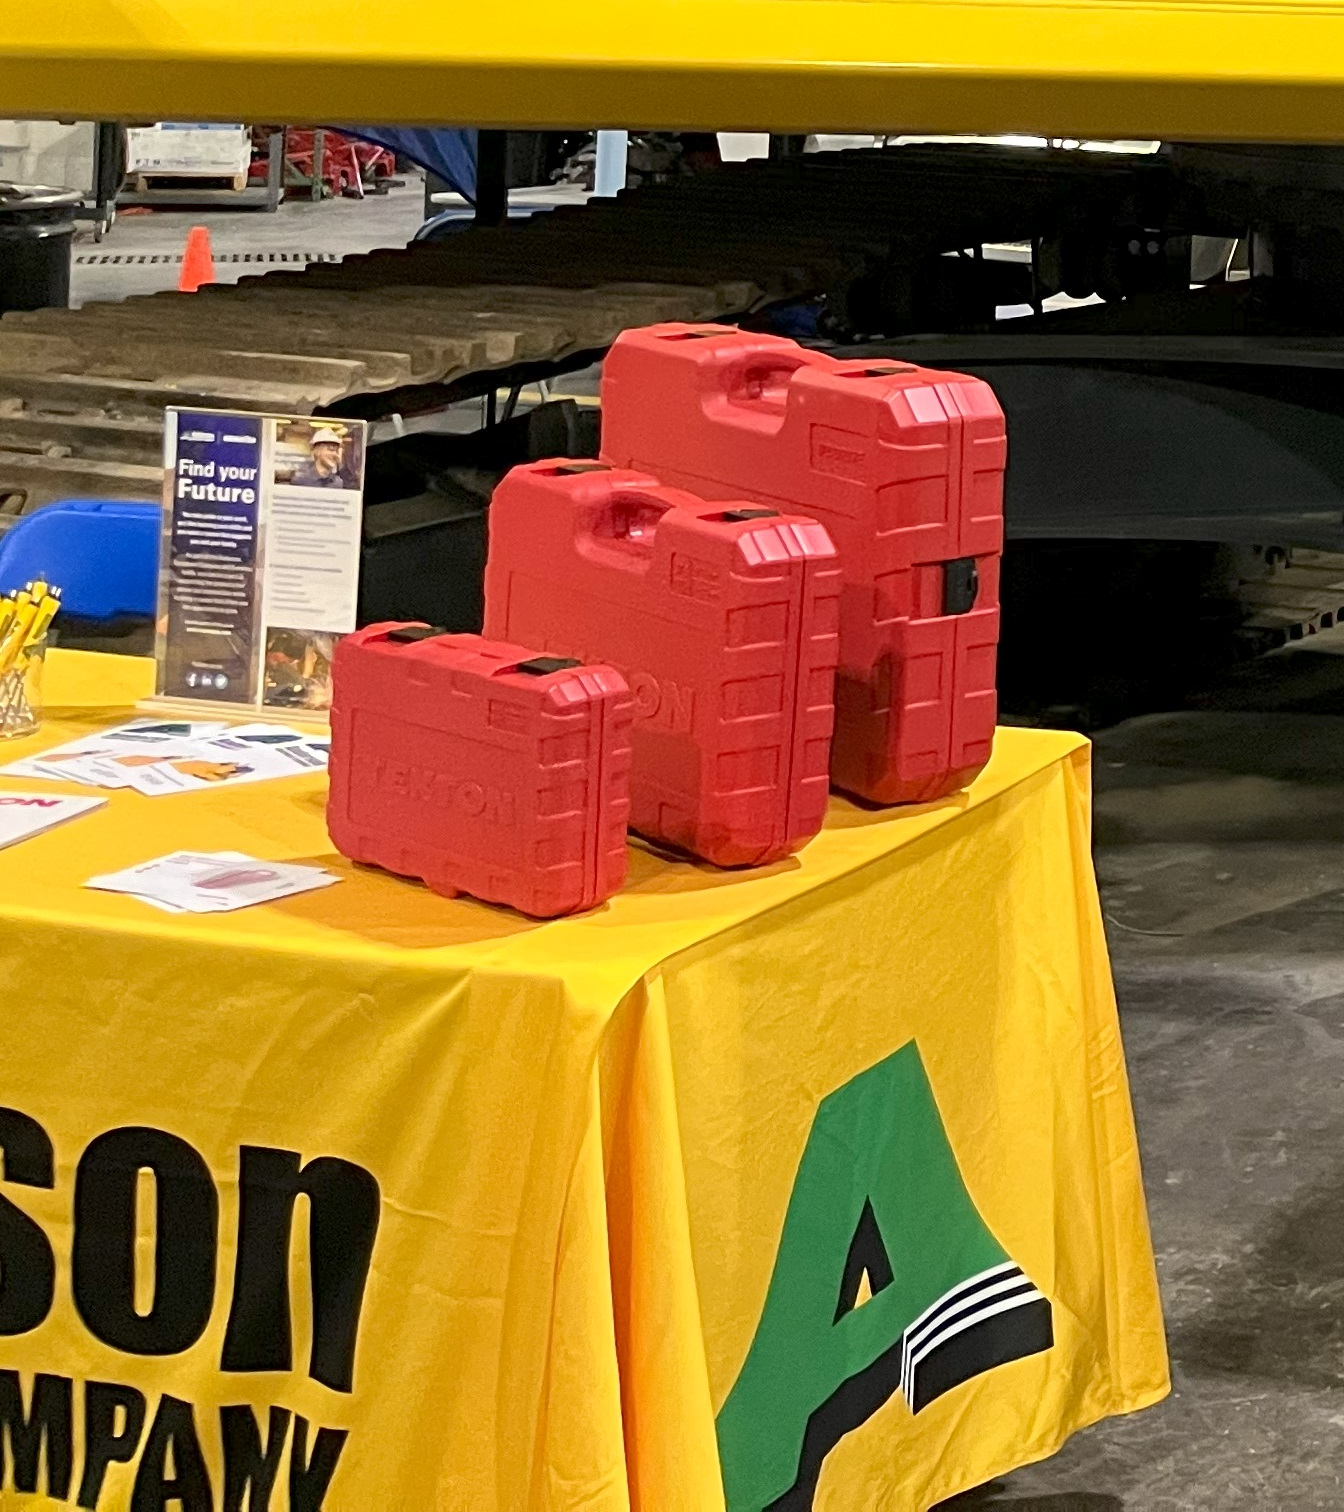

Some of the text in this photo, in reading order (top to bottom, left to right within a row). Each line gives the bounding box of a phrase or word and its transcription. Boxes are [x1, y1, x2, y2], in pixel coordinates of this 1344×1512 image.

[178, 458, 257, 482] Find your
[178, 478, 256, 505] Future
[0, 1368, 350, 1512] MPANY
